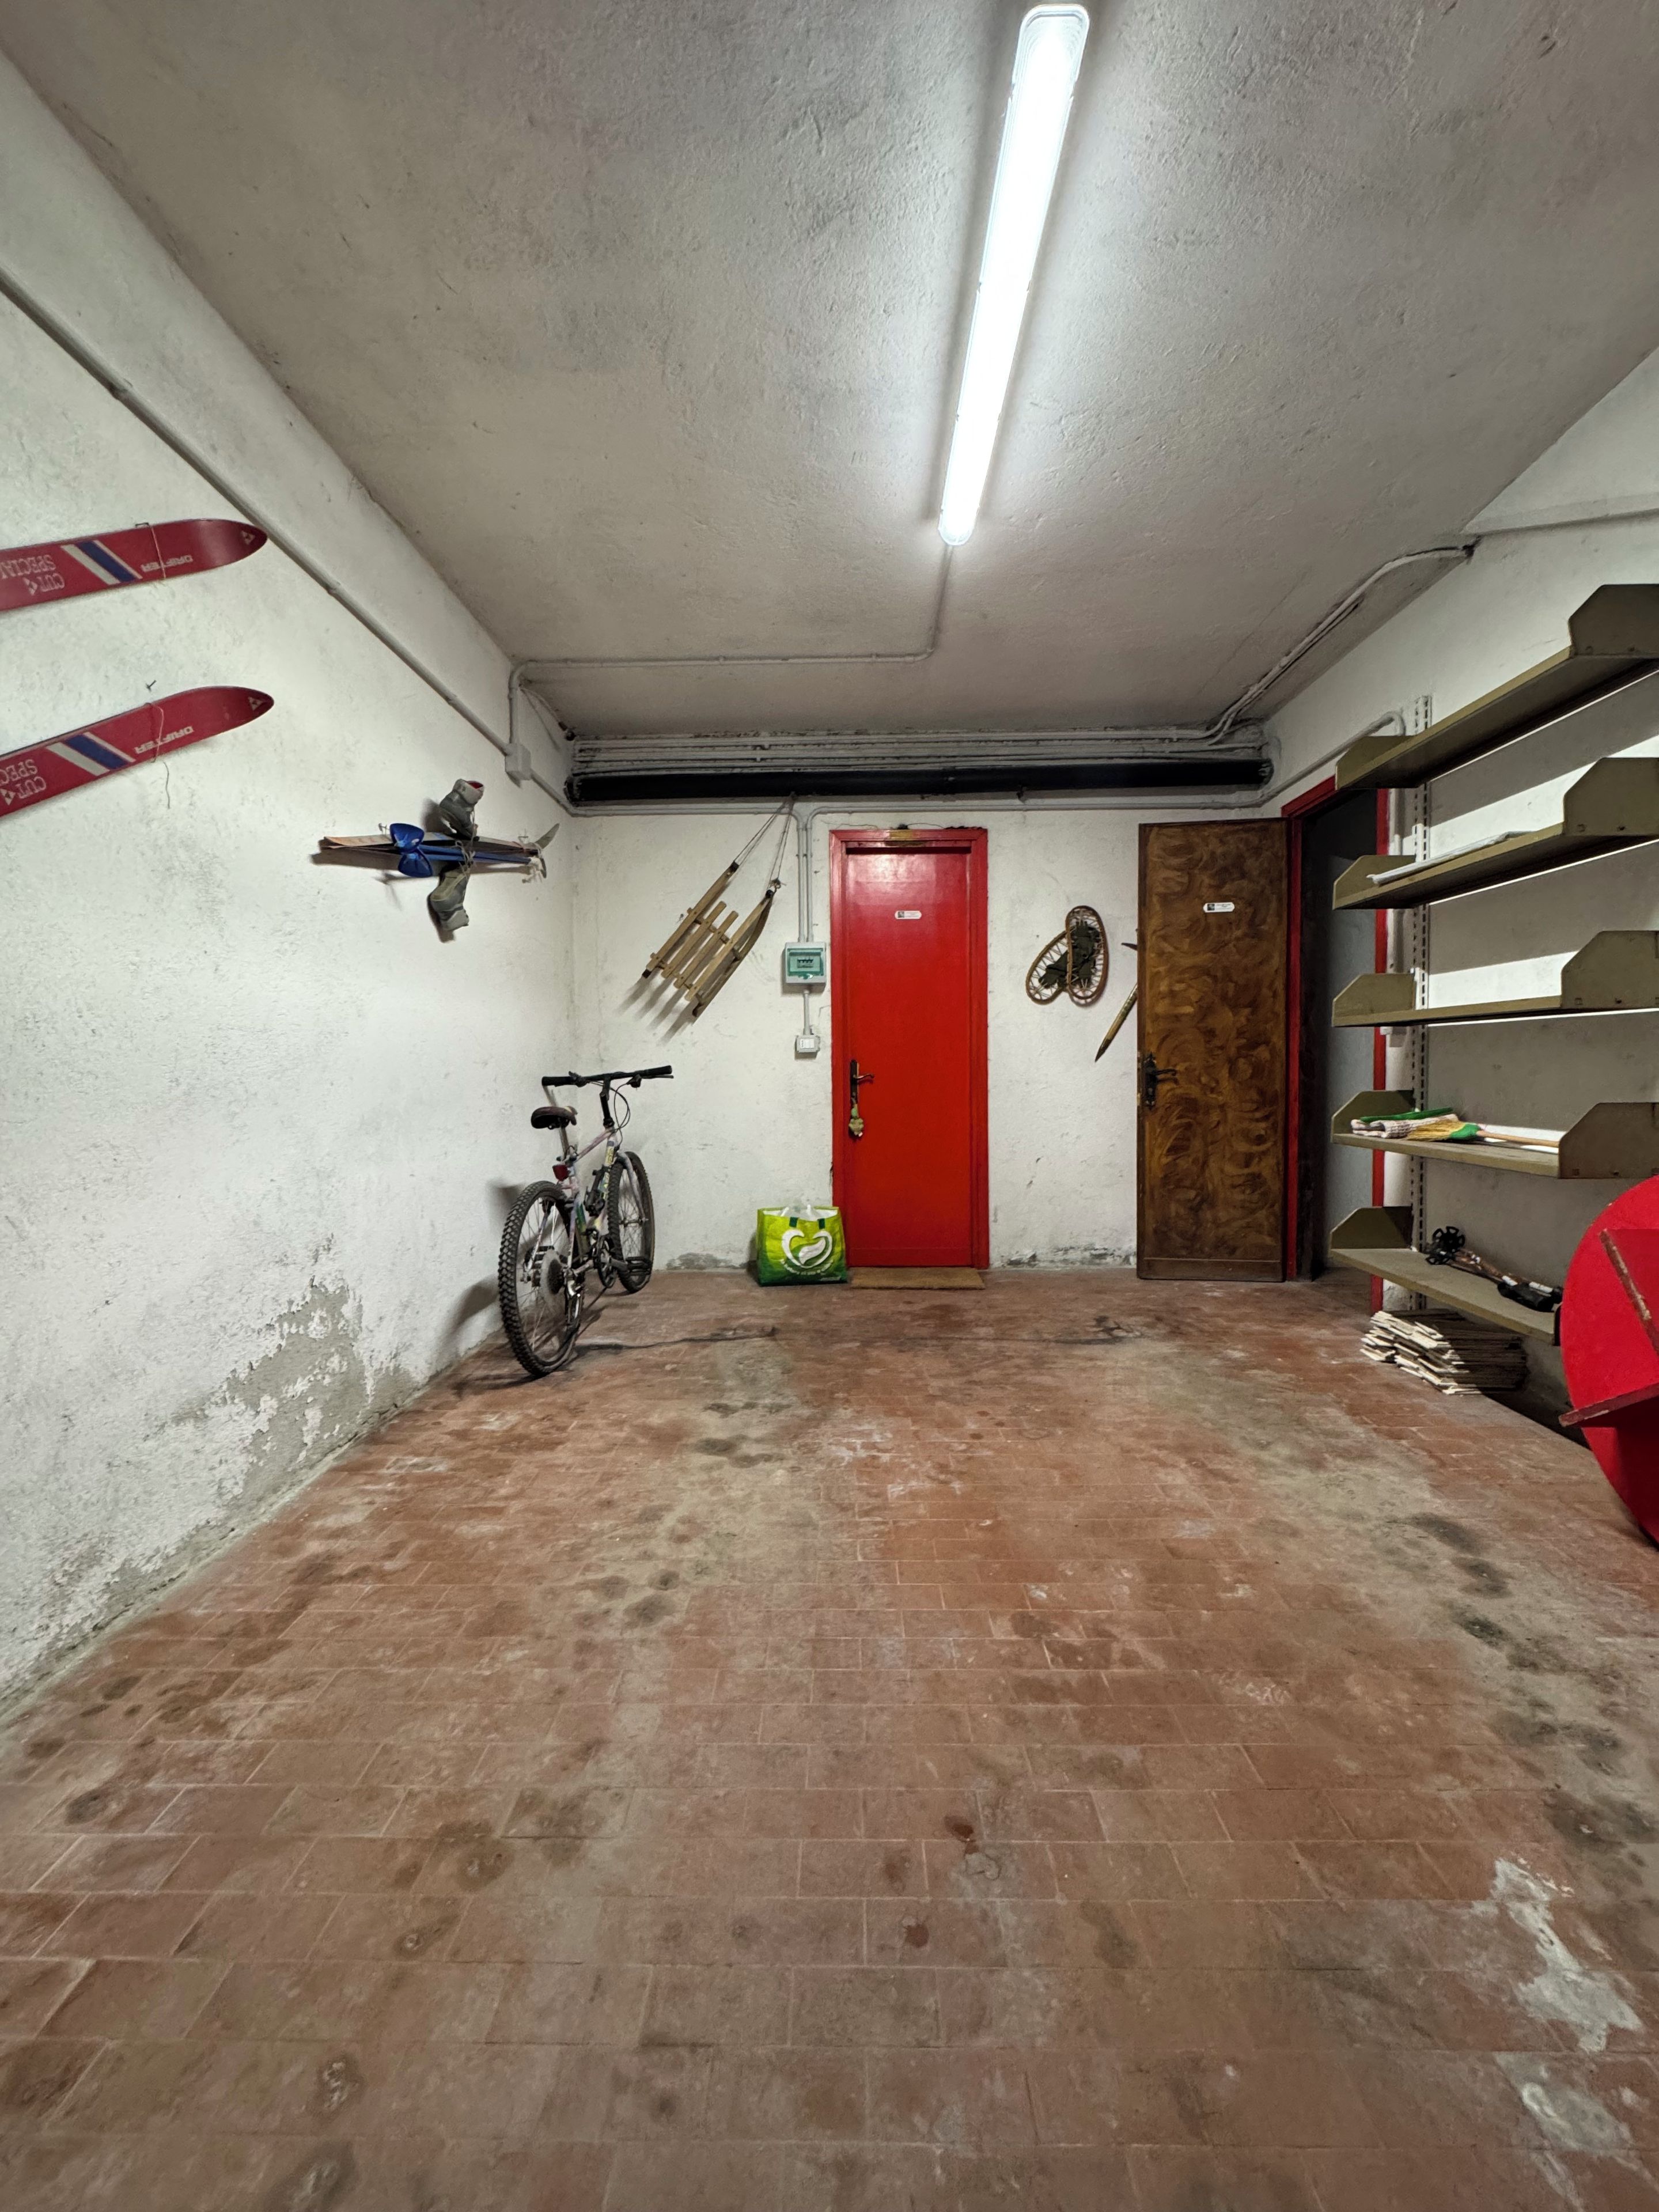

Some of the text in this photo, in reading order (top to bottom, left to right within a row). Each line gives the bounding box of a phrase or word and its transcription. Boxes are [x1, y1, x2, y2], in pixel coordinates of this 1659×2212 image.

[140, 555, 194, 573] DRIFTER
[36, 573, 65, 592] CUT
[134, 726, 195, 754] DRIFTER
[15, 777, 47, 799] CUT
